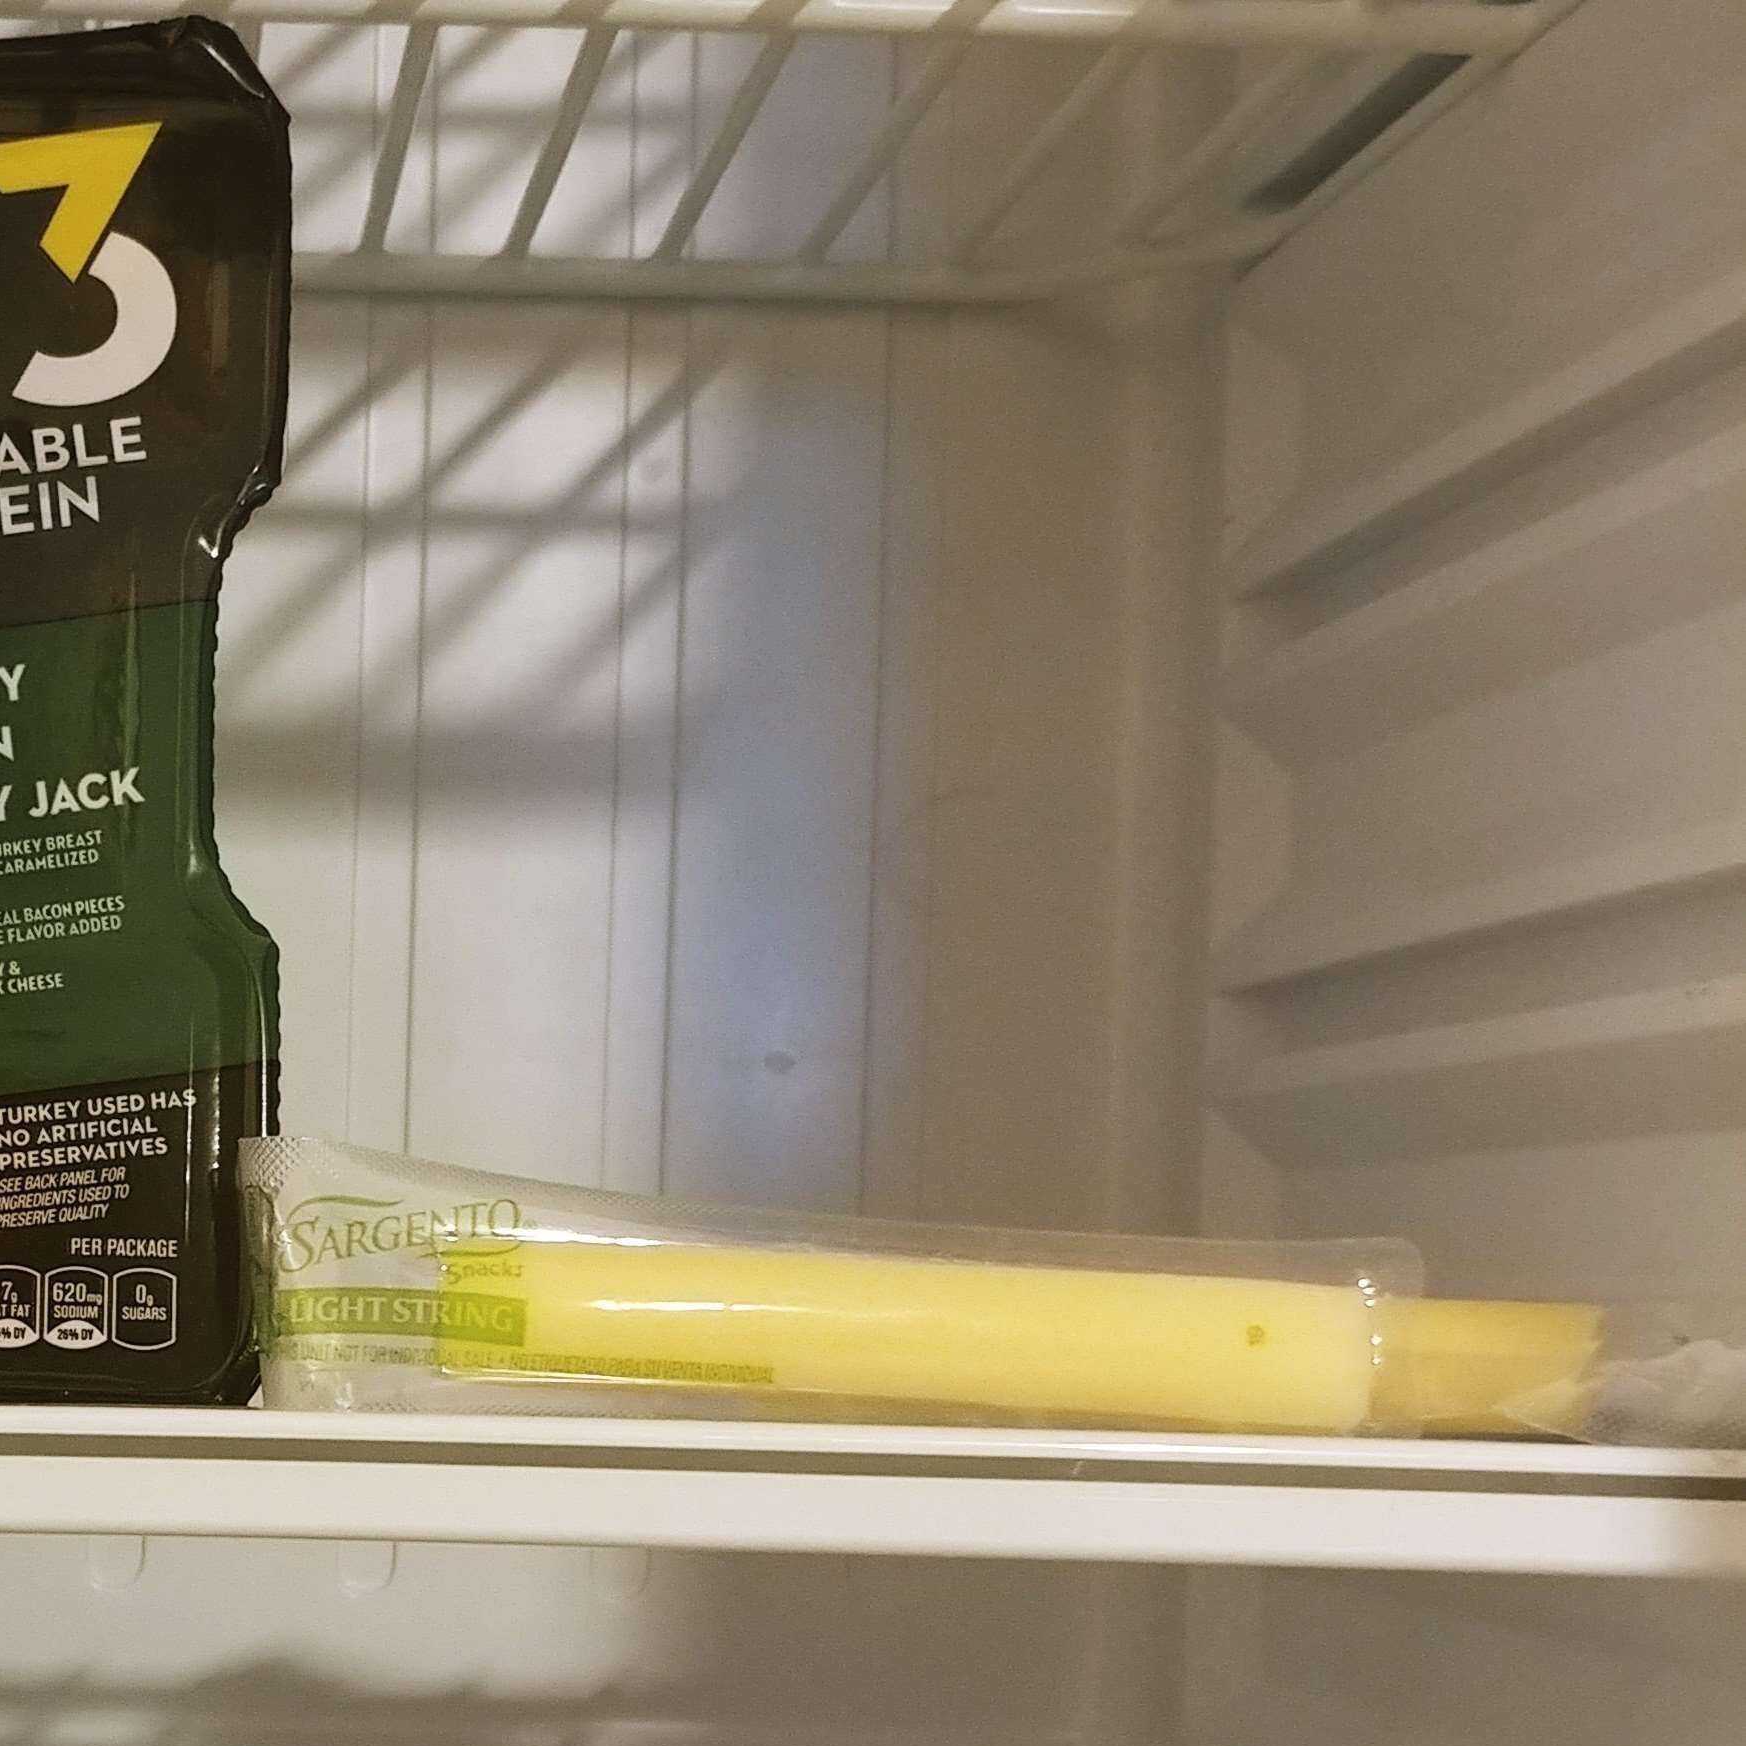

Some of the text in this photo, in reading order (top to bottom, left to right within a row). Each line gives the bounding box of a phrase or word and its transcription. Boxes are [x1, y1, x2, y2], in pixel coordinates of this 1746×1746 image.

[29, 767, 146, 818] JACK
[46, 830, 103, 851] BREAST
[24, 902, 73, 922] BACON
[75, 895, 125, 916] PIECES
[7, 922, 65, 943] FLAVOR
[70, 915, 122, 935] ADDED
[9, 961, 21, 974] &
[7, 973, 64, 994] CHEESE
[87, 1094, 145, 1117] USED
[152, 1088, 197, 1110] HAS
[37, 1116, 158, 1145] ARTIFICIAL
[70, 1237, 178, 1257] PER PACKAGE
[279, 1197, 521, 1273] SARGENTO
[1, 1281, 17, 1302] 7g
[52, 1282, 102, 1305] 620mg
[135, 1285, 153, 1305] 0g
[11, 1304, 30, 1317] FAT
[54, 1305, 98, 1318] SODIUM
[122, 1307, 167, 1320] SUGARS
[289, 1296, 513, 1332] LIGHT STRING
